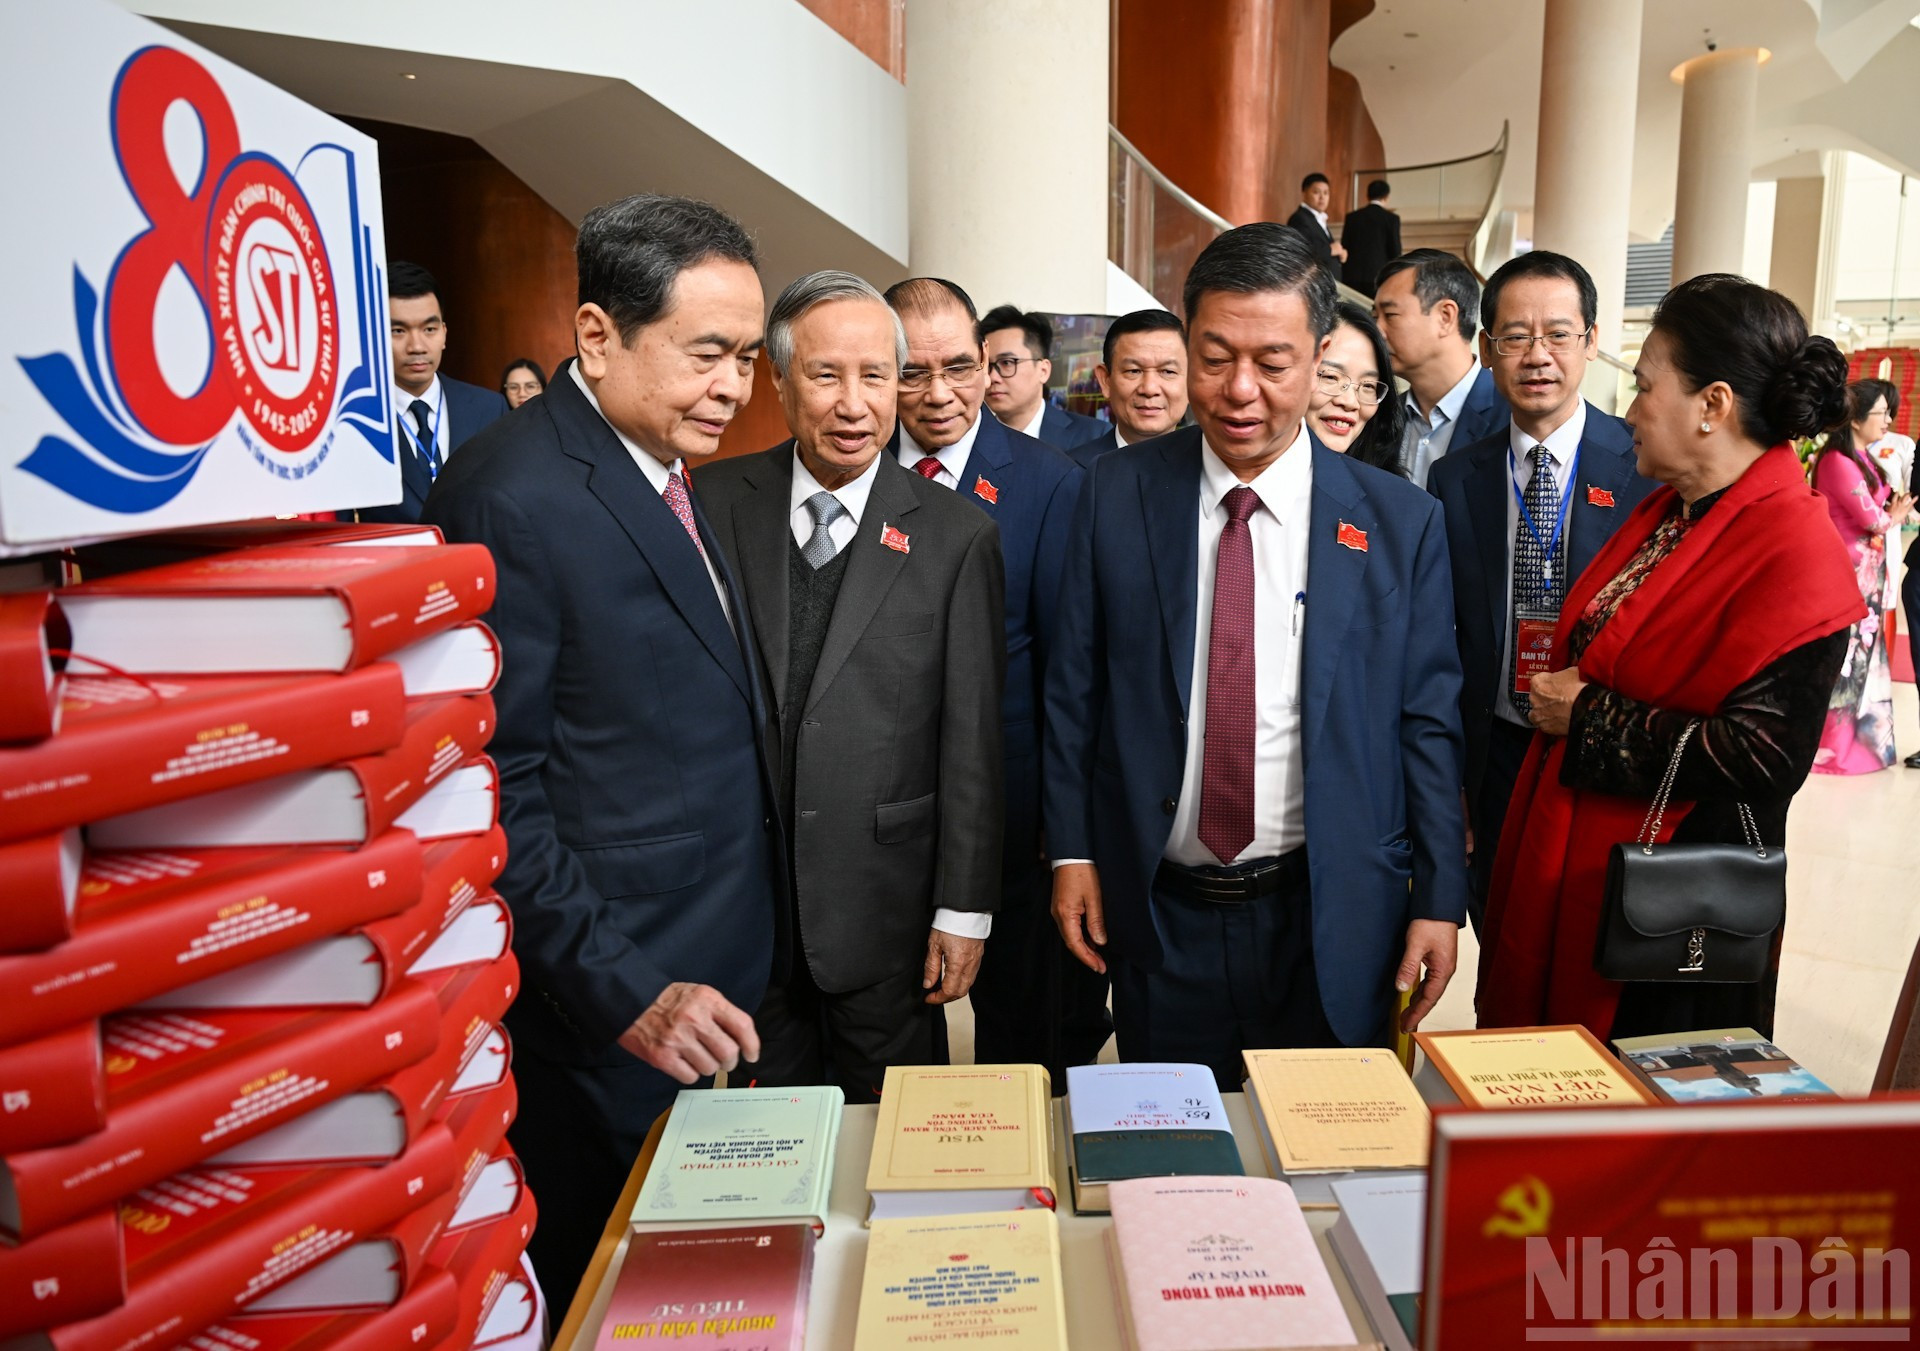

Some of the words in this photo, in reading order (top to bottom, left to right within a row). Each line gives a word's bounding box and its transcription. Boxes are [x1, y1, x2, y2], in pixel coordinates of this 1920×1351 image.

[248, 243, 300, 371] ST
[253, 398, 318, 436] 1945-2025
[1521, 652, 1535, 660] BAN
[1537, 651, 1546, 660] TỔ
[1485, 1083, 1545, 1095] NAM
[1550, 1080, 1613, 1093] VIỆT
[1506, 1095, 1546, 1106] HỘI
[1551, 1091, 1609, 1104] QUỐC
[1114, 1118, 1139, 1126] TẬP
[1142, 1119, 1188, 1127] TUYỂN
[757, 1140, 774, 1148] CHỦ
[776, 1139, 791, 1147] HỘI
[937, 1134, 963, 1144] SỰ
[964, 1134, 984, 1143] VÌ
[708, 1141, 726, 1149] VIỆT
[709, 1153, 734, 1161] THIỆN
[763, 1152, 774, 1160] ĐỂ
[756, 1236, 771, 1247] ST
[1188, 1271, 1215, 1282] TẬP
[1221, 1270, 1269, 1282] TUYỂN
[1161, 1286, 1211, 1301] TRỌNG
[1214, 1286, 1245, 1300] PHÚ
[1248, 1284, 1306, 1300] NGUYỄN
[651, 1303, 684, 1320] SỬ
[690, 1299, 747, 1320] TIỂU
[612, 1323, 656, 1339] LINH
[661, 1321, 698, 1338] VĂN
[702, 1314, 776, 1339] NGUYỄN
